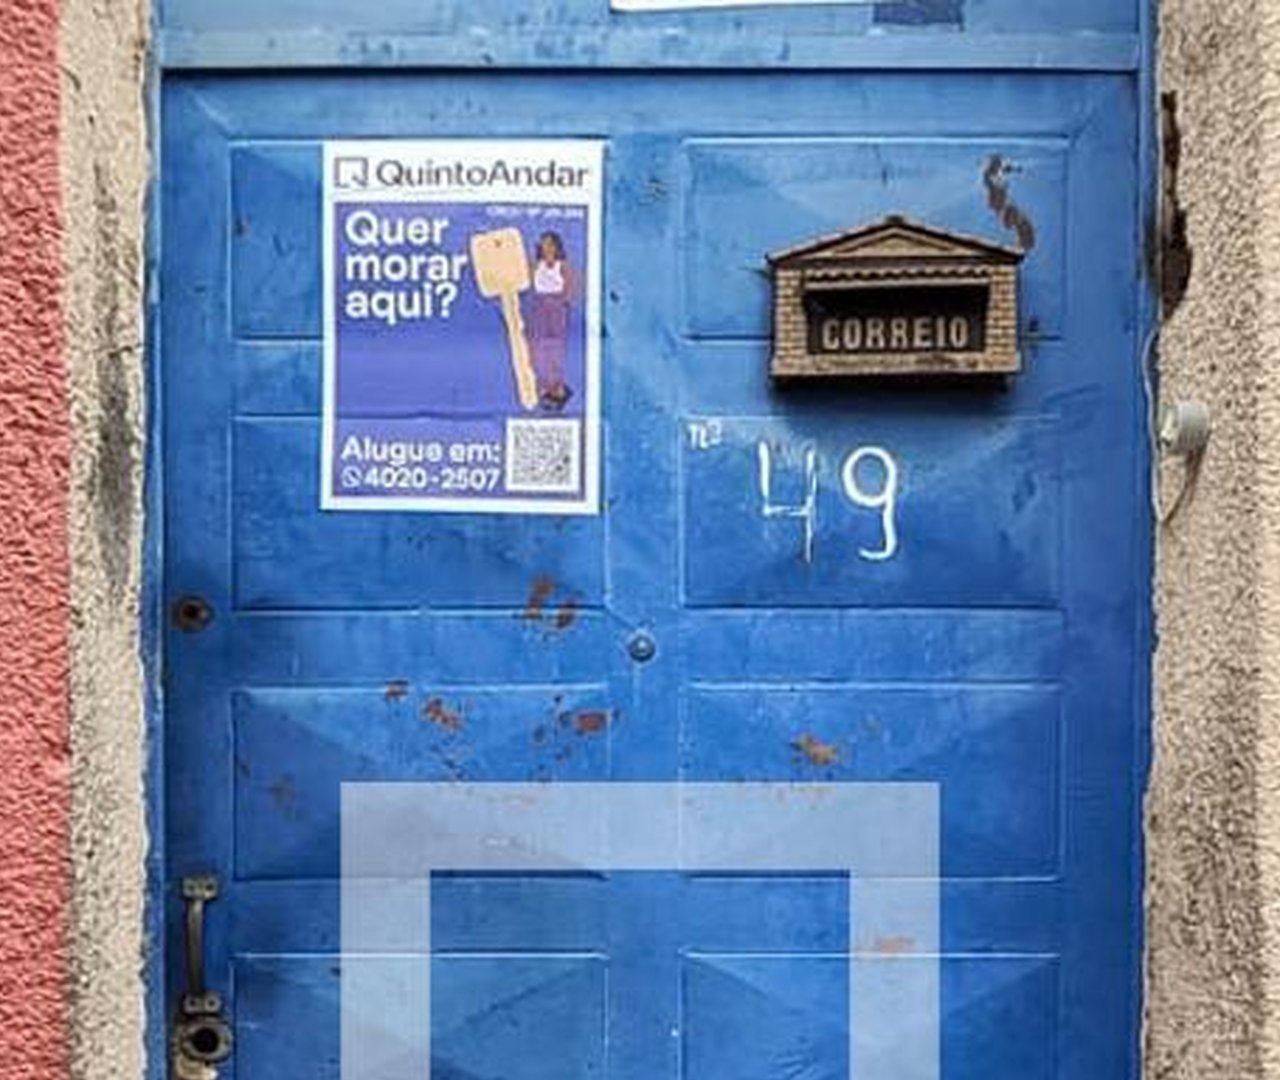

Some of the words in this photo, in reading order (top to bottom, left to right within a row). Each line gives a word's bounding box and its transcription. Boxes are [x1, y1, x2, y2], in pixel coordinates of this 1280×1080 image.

[376, 159, 588, 187] QuintoAndar
[344, 210, 449, 247] Quer
[345, 252, 468, 281] morar
[345, 282, 458, 325] aqui?
[822, 317, 969, 350] CORREIO
[340, 436, 443, 467] Alugue
[448, 442, 501, 463] em:
[758, 440, 898, 562] 49
